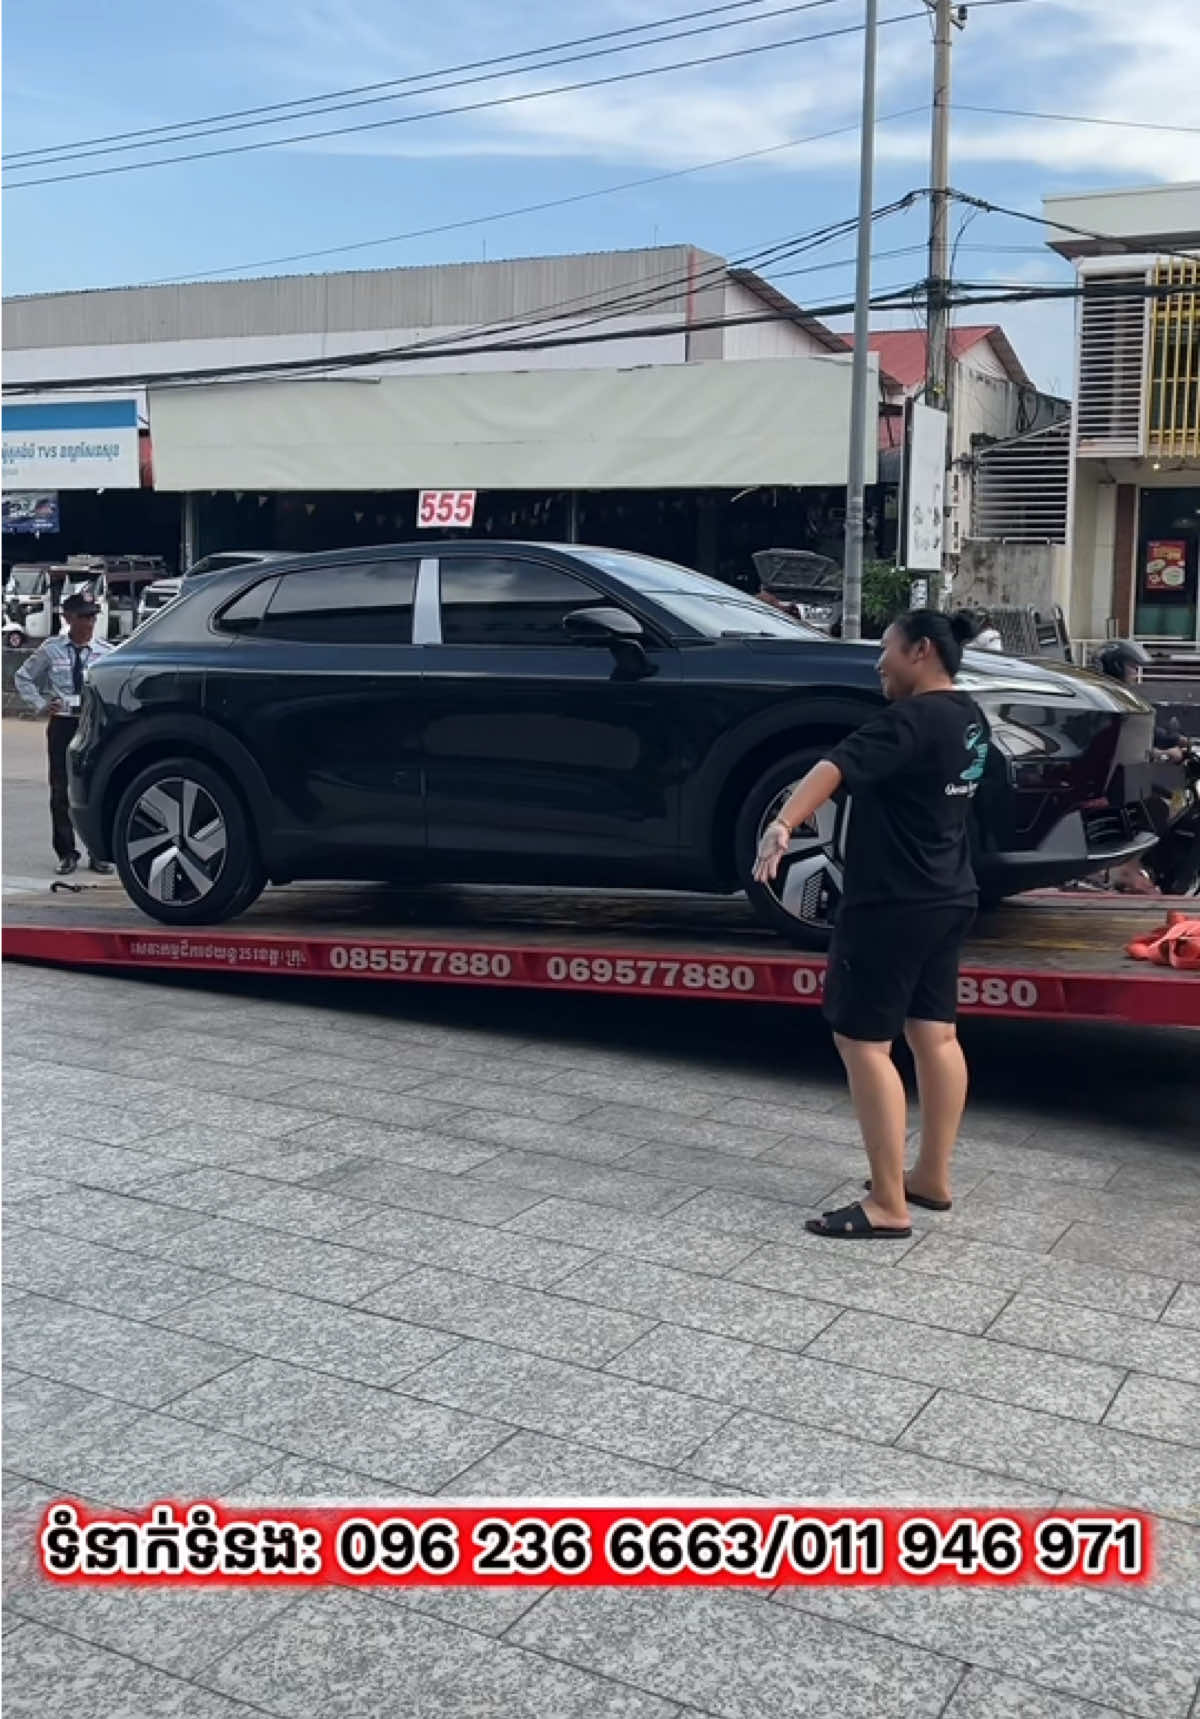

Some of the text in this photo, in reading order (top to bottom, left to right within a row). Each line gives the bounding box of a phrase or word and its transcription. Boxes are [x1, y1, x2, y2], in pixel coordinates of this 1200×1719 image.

[38, 445, 57, 459] TVS
[421, 493, 473, 522] 555
[329, 946, 512, 978] 085577880
[546, 956, 755, 991] 069577880
